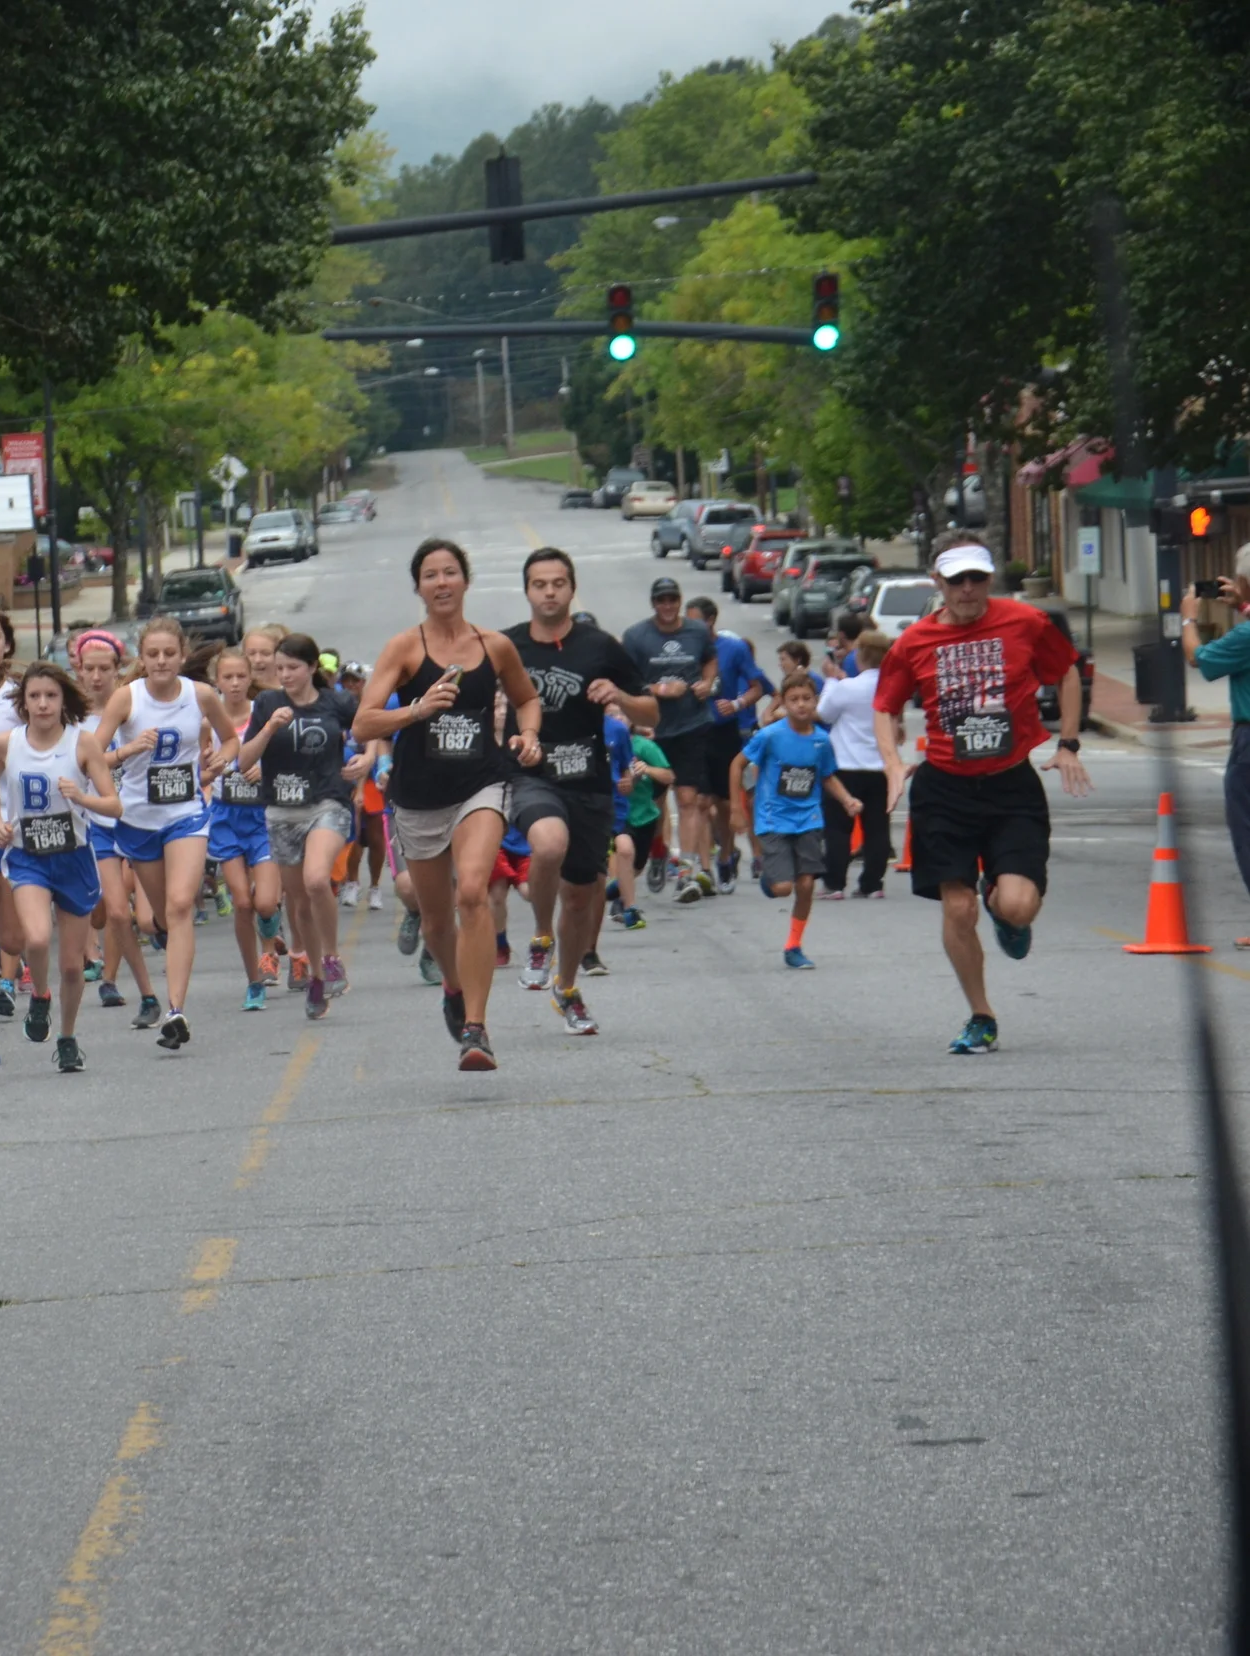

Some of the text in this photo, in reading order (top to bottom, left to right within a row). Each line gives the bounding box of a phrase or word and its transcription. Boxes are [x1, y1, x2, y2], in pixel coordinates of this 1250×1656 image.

[152, 727, 181, 764] B
[288, 717, 328, 753] 15
[19, 771, 51, 812] B
